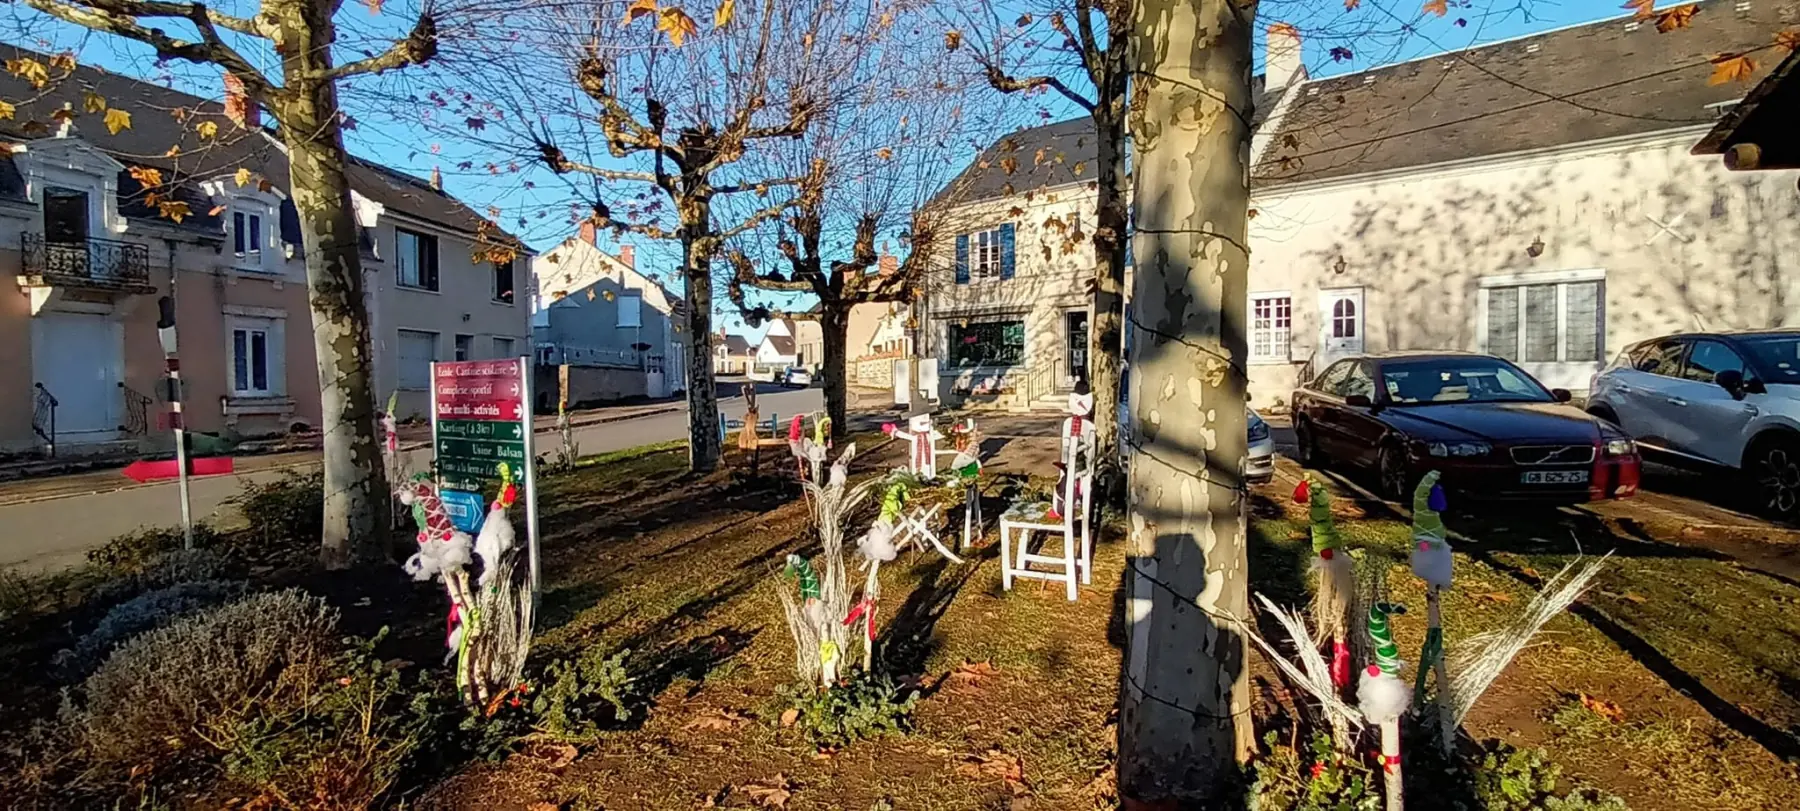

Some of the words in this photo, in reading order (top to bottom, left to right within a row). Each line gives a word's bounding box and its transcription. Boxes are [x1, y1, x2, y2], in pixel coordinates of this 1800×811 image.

[456, 365, 480, 376] Cantine
[482, 364, 507, 375] scolaire
[438, 385, 468, 398] Complexe
[470, 384, 492, 398] sportif
[438, 403, 452, 414] Salle
[440, 422, 466, 436] Karting
[472, 444, 493, 455] Usine
[497, 445, 523, 458] Balsan
